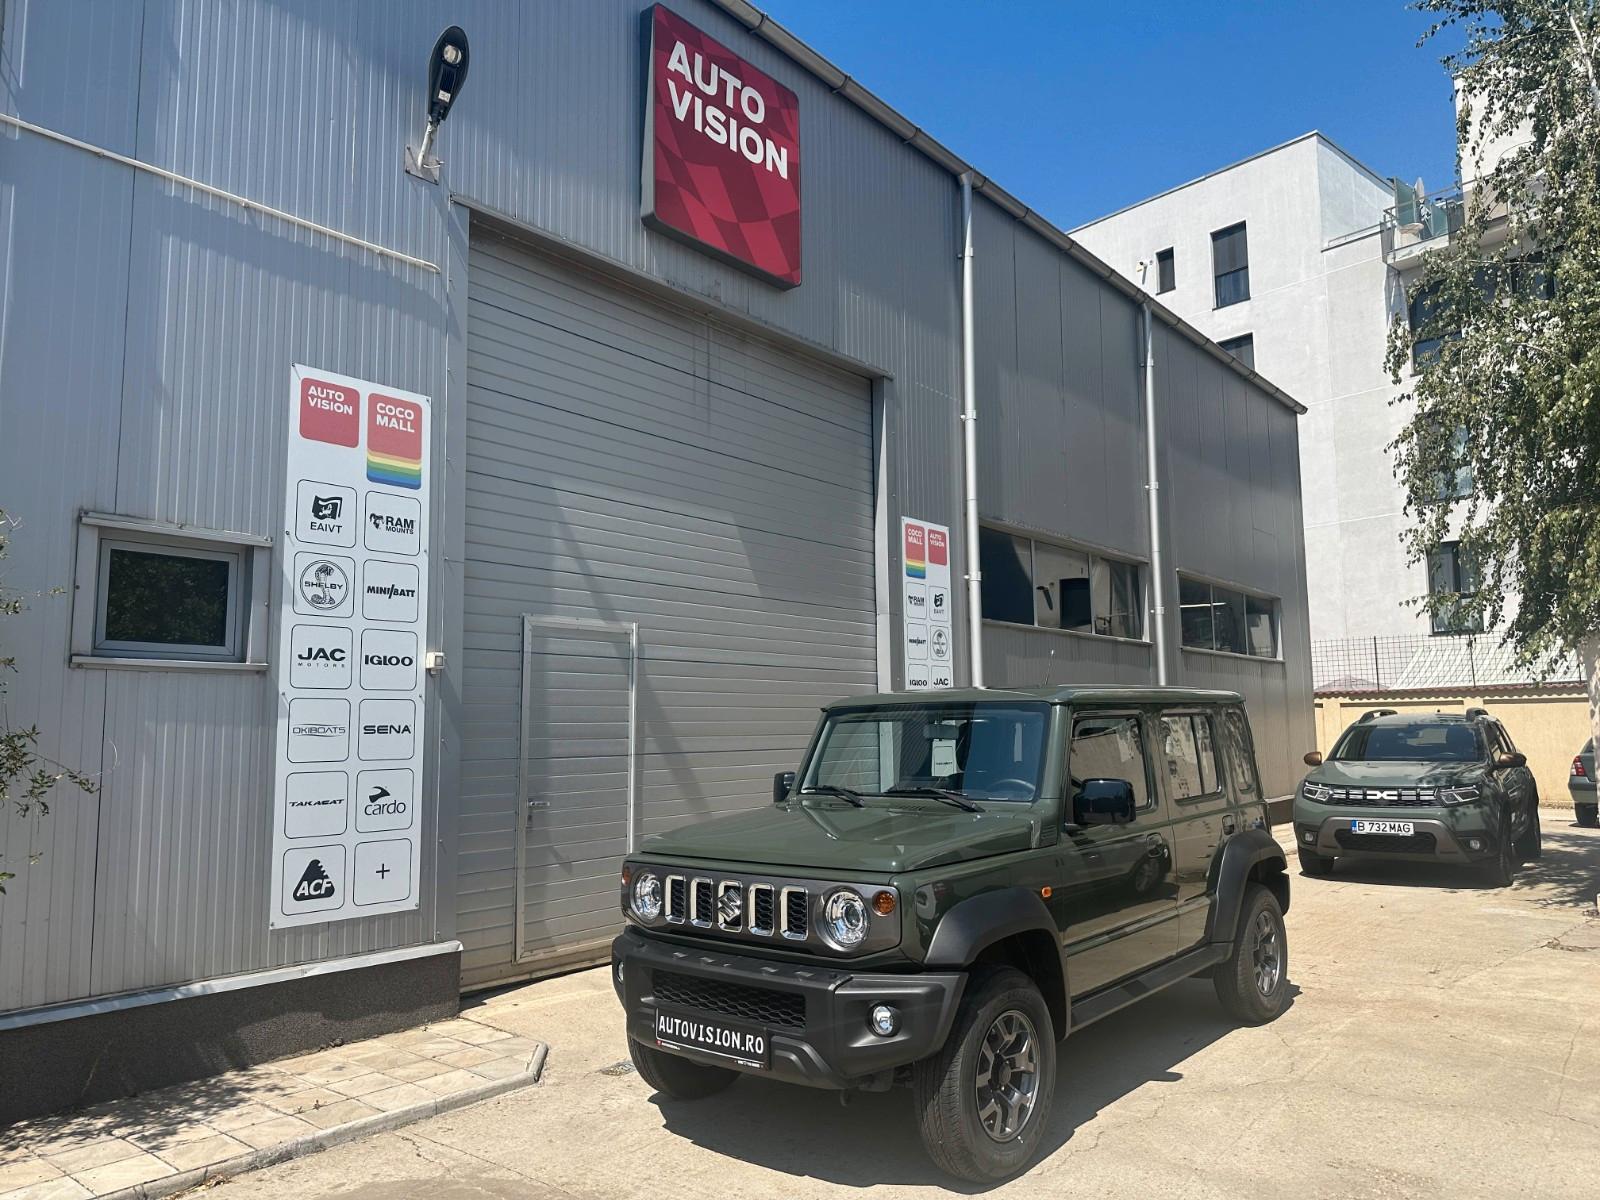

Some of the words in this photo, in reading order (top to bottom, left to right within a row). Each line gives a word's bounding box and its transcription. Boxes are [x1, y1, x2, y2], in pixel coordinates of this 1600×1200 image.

[667, 40, 765, 124] AUTO
[667, 79, 788, 180] VISION
[308, 385, 345, 402] AUTO
[308, 396, 353, 415] VISION
[376, 402, 414, 420] COCO
[376, 414, 415, 433] MALL
[310, 521, 343, 534] EAIVT
[385, 515, 414, 529] RAM
[385, 526, 414, 535] MOUNTS
[304, 580, 344, 590] SHELBY
[297, 647, 346, 662] JAC
[364, 654, 414, 667] IGLOO
[933, 677, 949, 686] JAC
[292, 726, 346, 735] OKIBOATS
[363, 724, 411, 735] SENA
[364, 799, 407, 816] cardo
[1358, 821, 1365, 832] B
[1369, 822, 1388, 832] 732
[1389, 823, 1411, 833] MAG
[296, 878, 332, 897] ACF
[658, 1015, 764, 1054] AUTOVISION.RO
